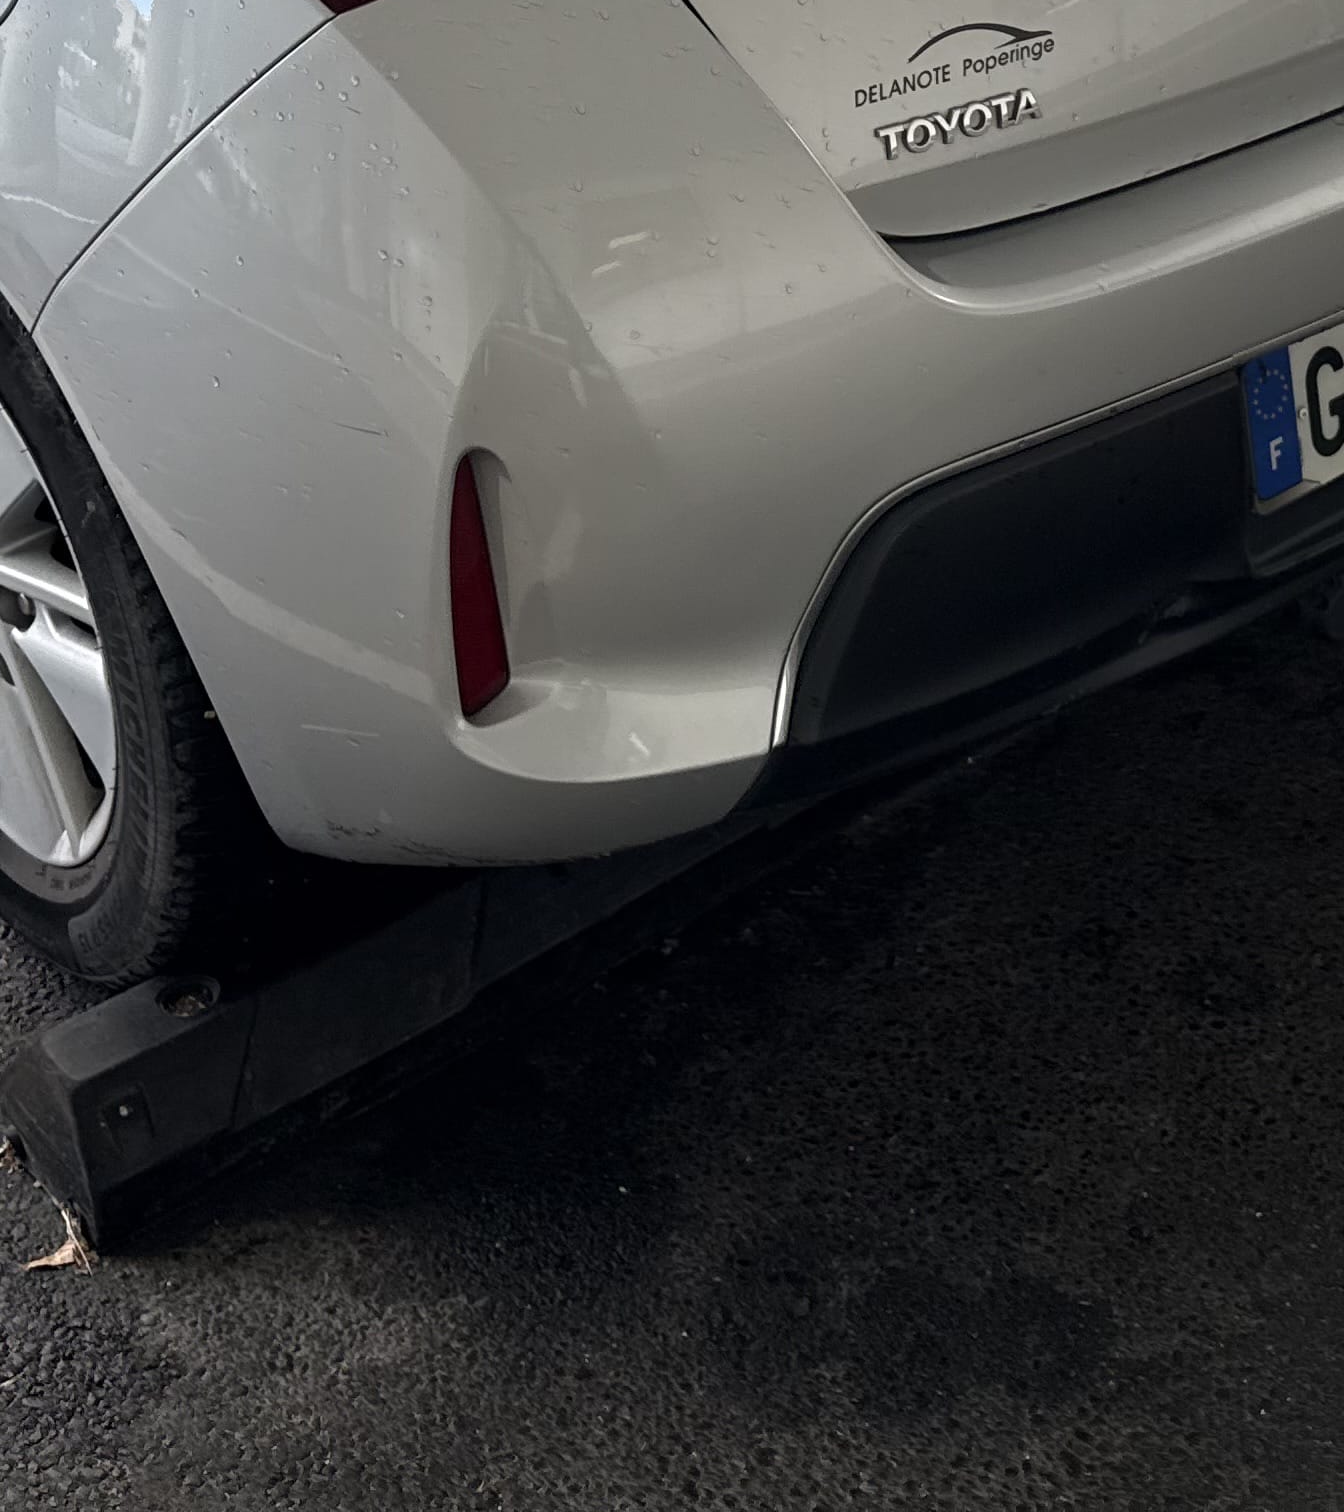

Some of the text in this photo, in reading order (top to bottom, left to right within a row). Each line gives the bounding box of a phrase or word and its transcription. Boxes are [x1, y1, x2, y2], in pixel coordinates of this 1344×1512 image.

[854, 38, 1055, 108] DELANOTE Poperinge
[874, 88, 1042, 160] TOYOTA
[1268, 436, 1284, 471] F
